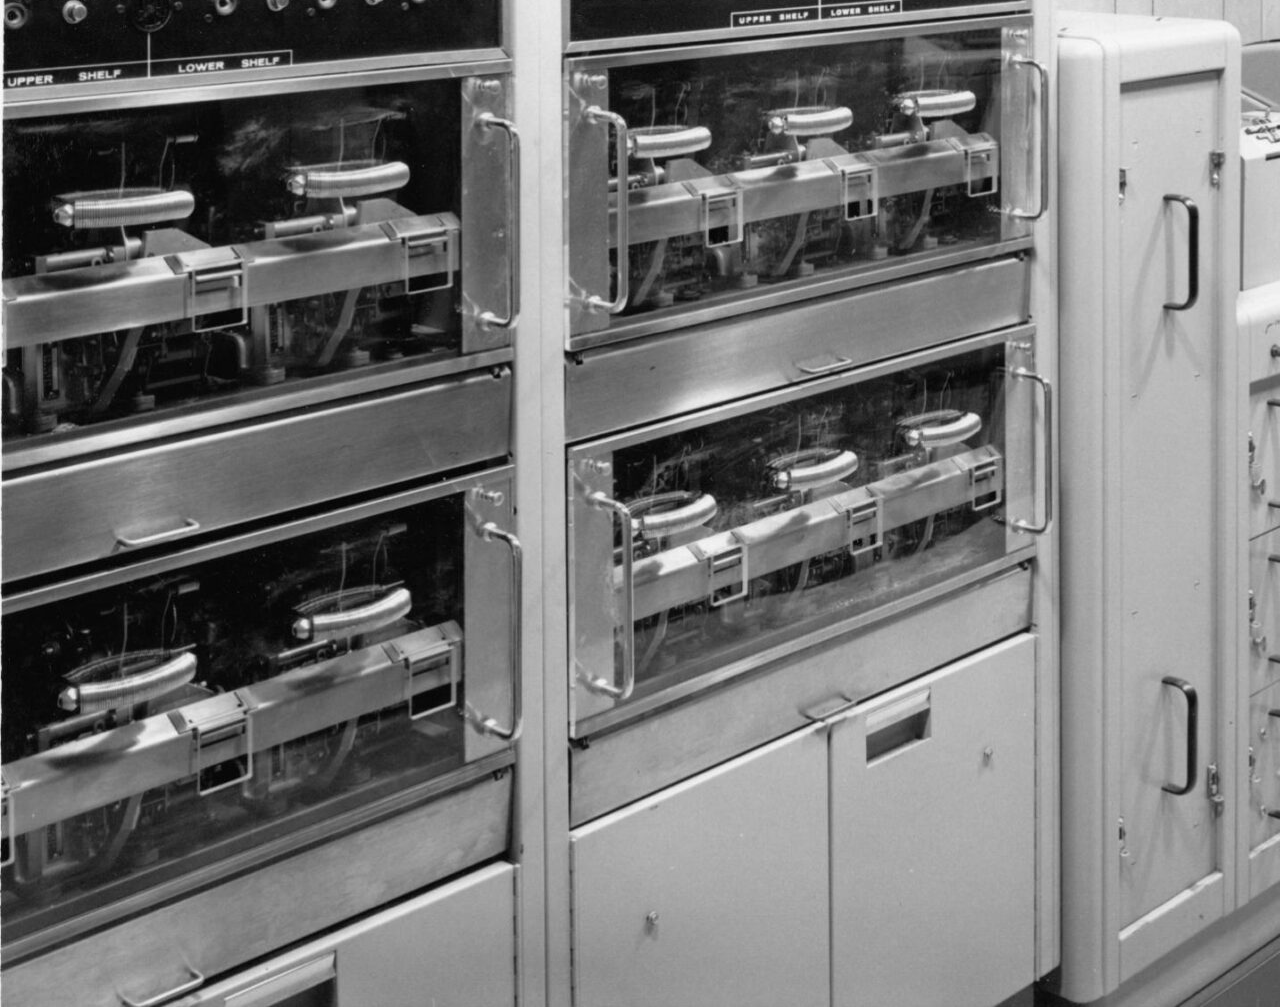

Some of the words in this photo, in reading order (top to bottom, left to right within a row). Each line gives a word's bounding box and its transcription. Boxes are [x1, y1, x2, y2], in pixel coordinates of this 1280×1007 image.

[739, 14, 772, 25] UPPER
[779, 10, 809, 21] SHELF
[830, 6, 862, 17] LOWER
[868, 3, 896, 14] SHELF
[178, 60, 225, 74] LOWER
[241, 56, 280, 68] SHELF
[7, 74, 54, 88] UPPER
[78, 68, 122, 82] SHELF
